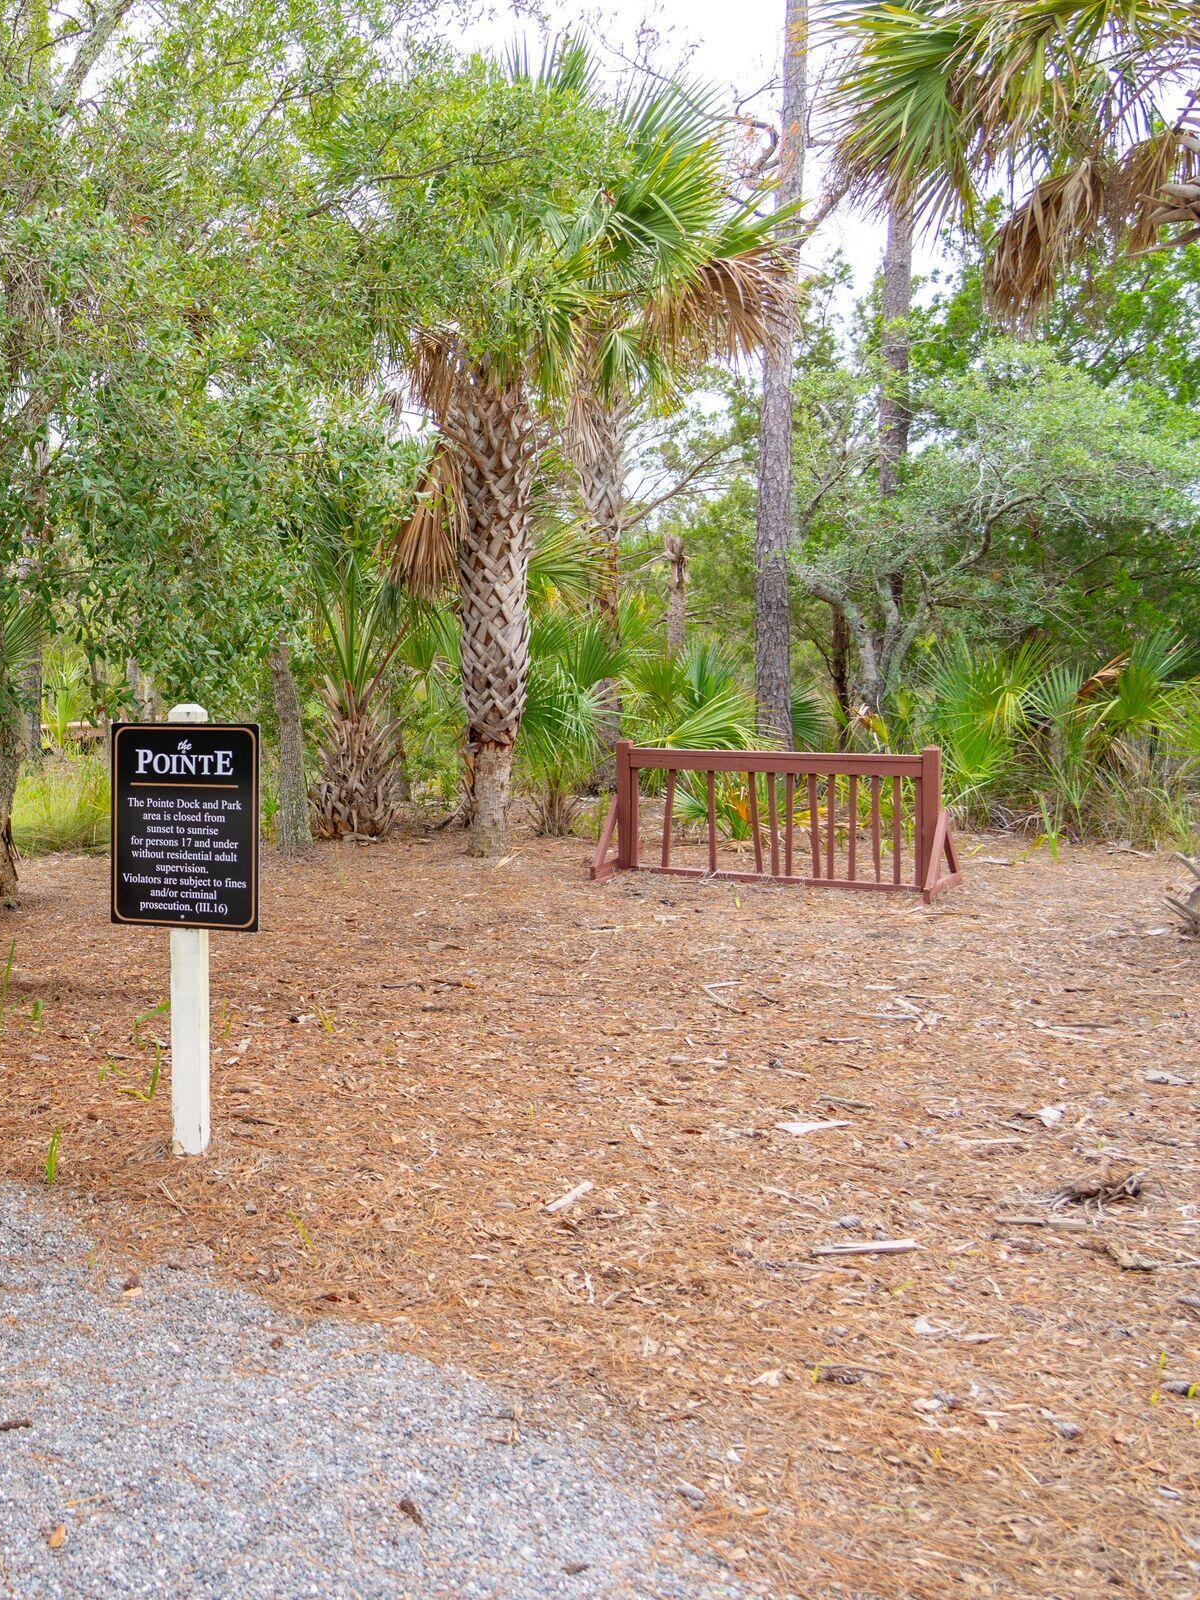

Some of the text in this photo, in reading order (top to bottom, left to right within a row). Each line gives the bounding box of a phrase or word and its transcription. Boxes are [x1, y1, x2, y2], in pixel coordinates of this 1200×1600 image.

[177, 739, 192, 751] the
[135, 749, 234, 775] POINTE
[127, 797, 242, 811] The Pointe Dock and Park
[142, 811, 226, 823] area is closed from
[146, 825, 219, 835] sunset to sunrise
[130, 835, 239, 849] for persons 17 and under
[131, 848, 237, 862] without residential adult
[155, 863, 209, 874] supervision.
[123, 873, 247, 888] Violators are subject to fines
[150, 888, 217, 900] and/or criminal
[140, 901, 228, 915] prosecution. (III.16)
